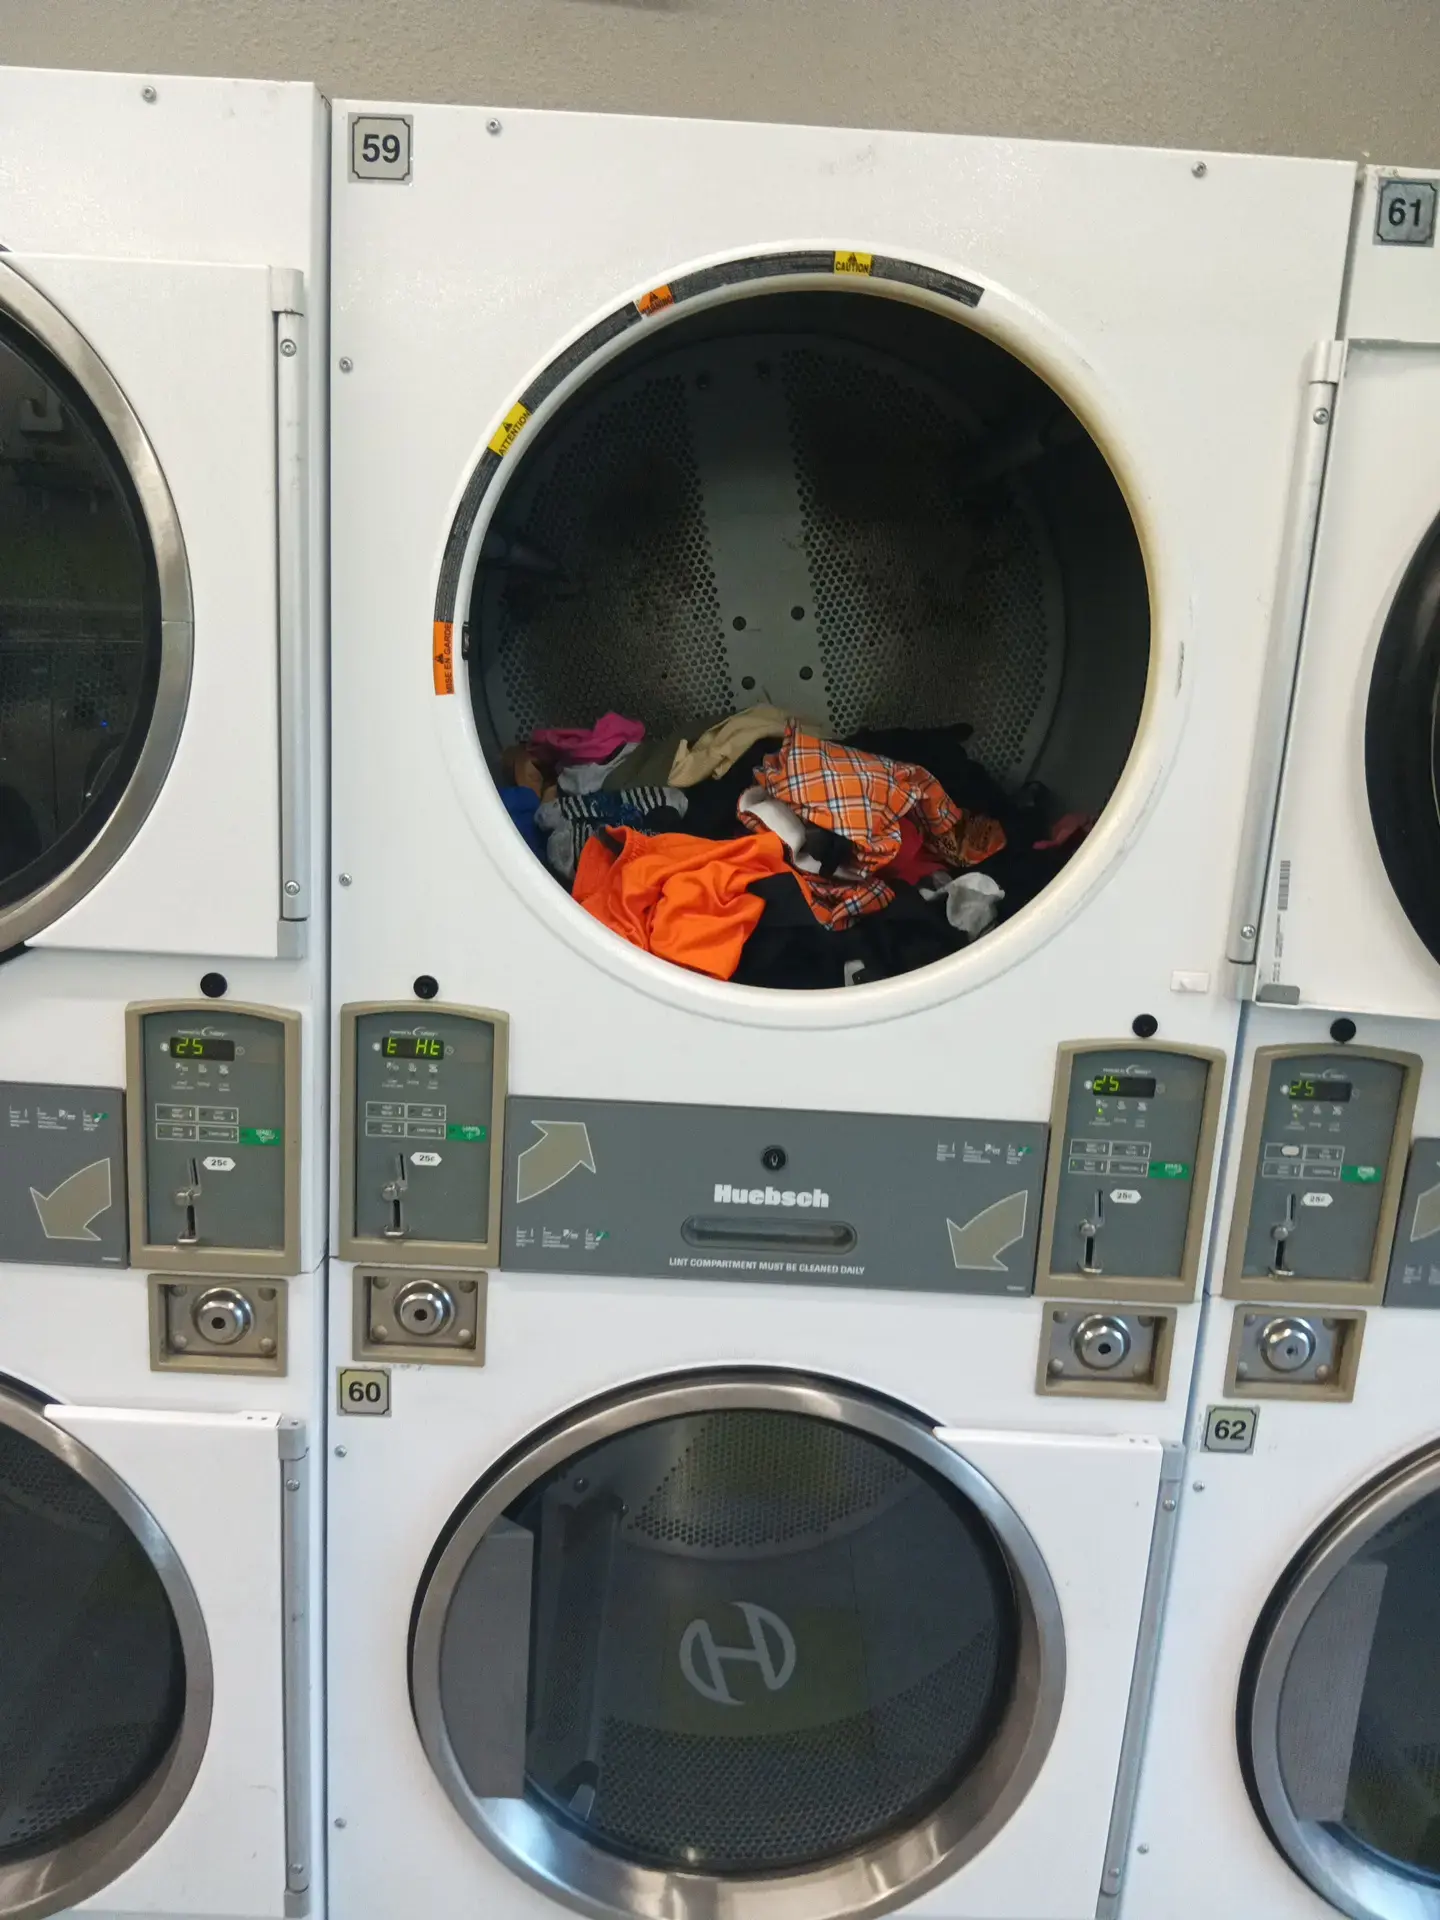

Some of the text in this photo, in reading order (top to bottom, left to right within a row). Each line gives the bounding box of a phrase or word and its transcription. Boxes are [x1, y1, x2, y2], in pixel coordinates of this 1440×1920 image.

[362, 134, 400, 163] 59
[1388, 198, 1421, 227] 61
[835, 261, 870, 274] CAUTION
[498, 411, 531, 456] ATTENTION
[443, 624, 452, 655] GARDE
[444, 657, 451, 670] EN
[176, 1037, 203, 1054] 25
[387, 1037, 397, 1054] E
[1093, 1075, 1120, 1092] 25
[1289, 1080, 1314, 1097] 25
[714, 1184, 829, 1208] Huebsch
[669, 1257, 865, 1275] LINT COMPARTMENT MUST BE CLEANED DAILY
[349, 1381, 381, 1402] 60
[1214, 1419, 1247, 1440] 62
